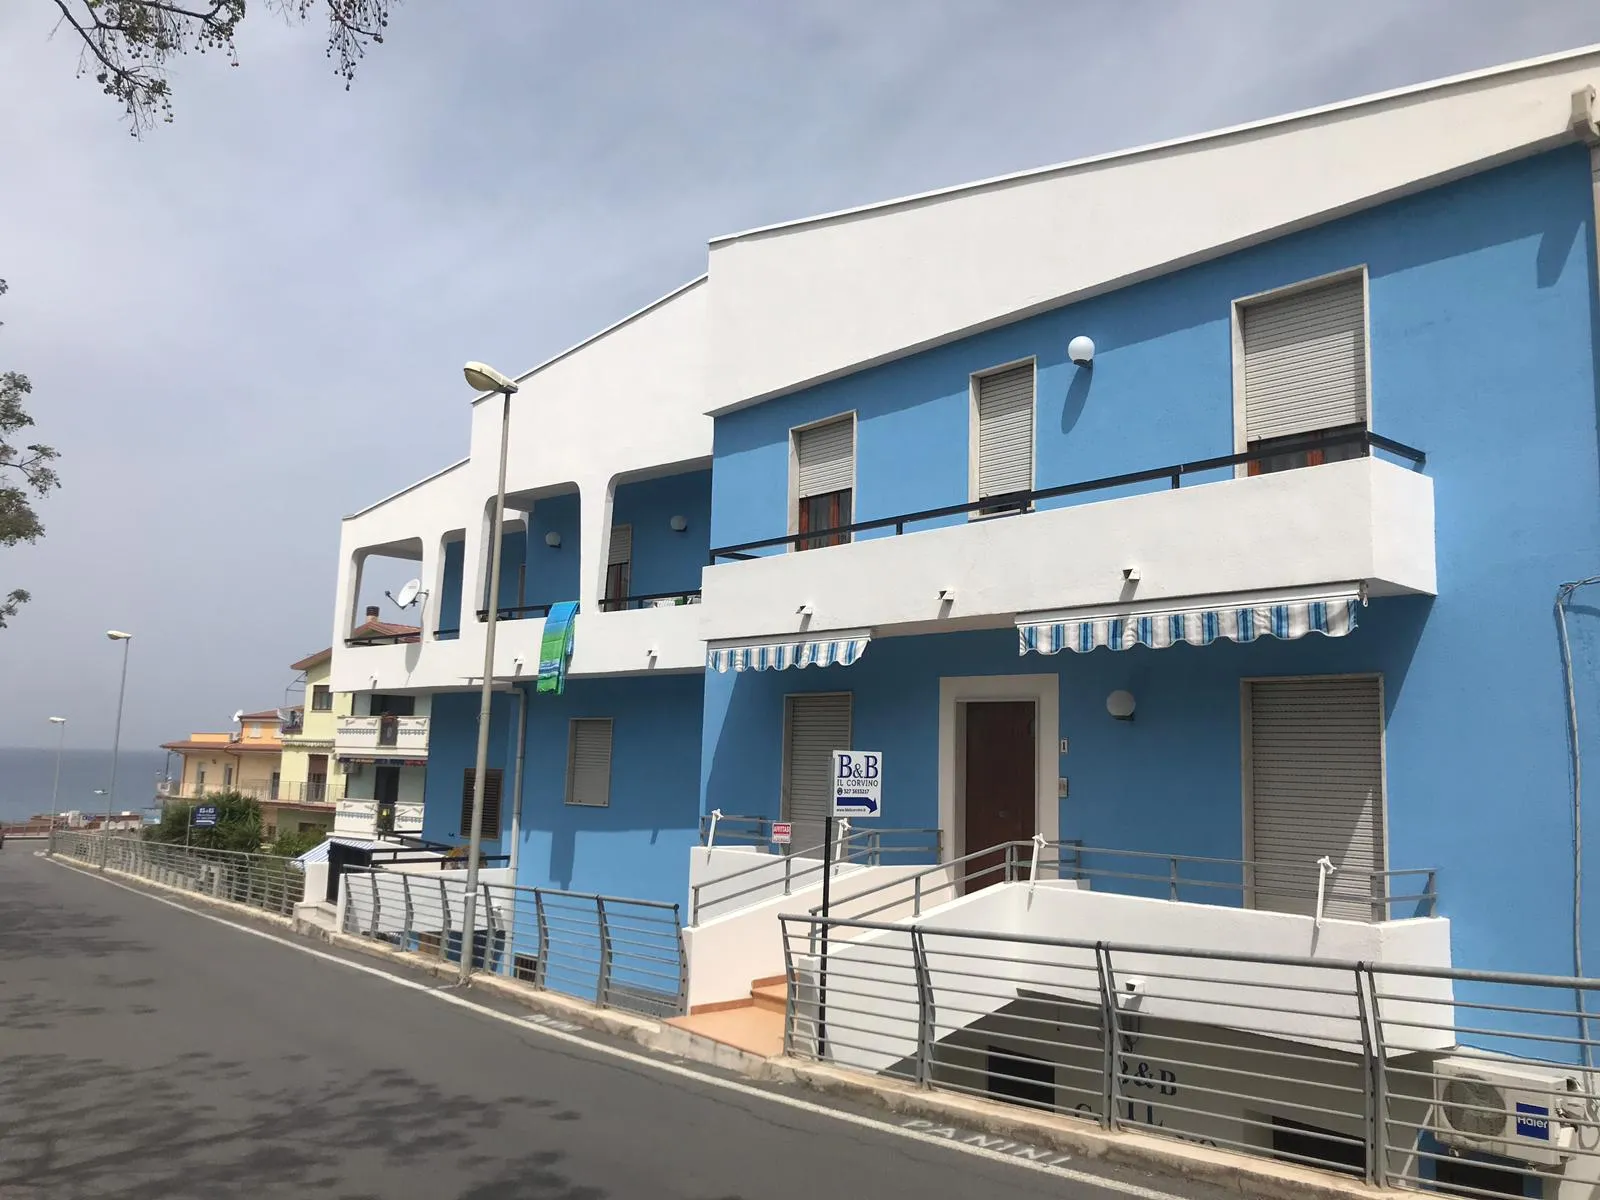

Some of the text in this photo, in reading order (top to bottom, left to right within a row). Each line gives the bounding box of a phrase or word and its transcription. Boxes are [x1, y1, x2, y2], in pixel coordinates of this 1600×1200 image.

[837, 754, 879, 779] B&B
[837, 779, 879, 787] IL CORVINO
